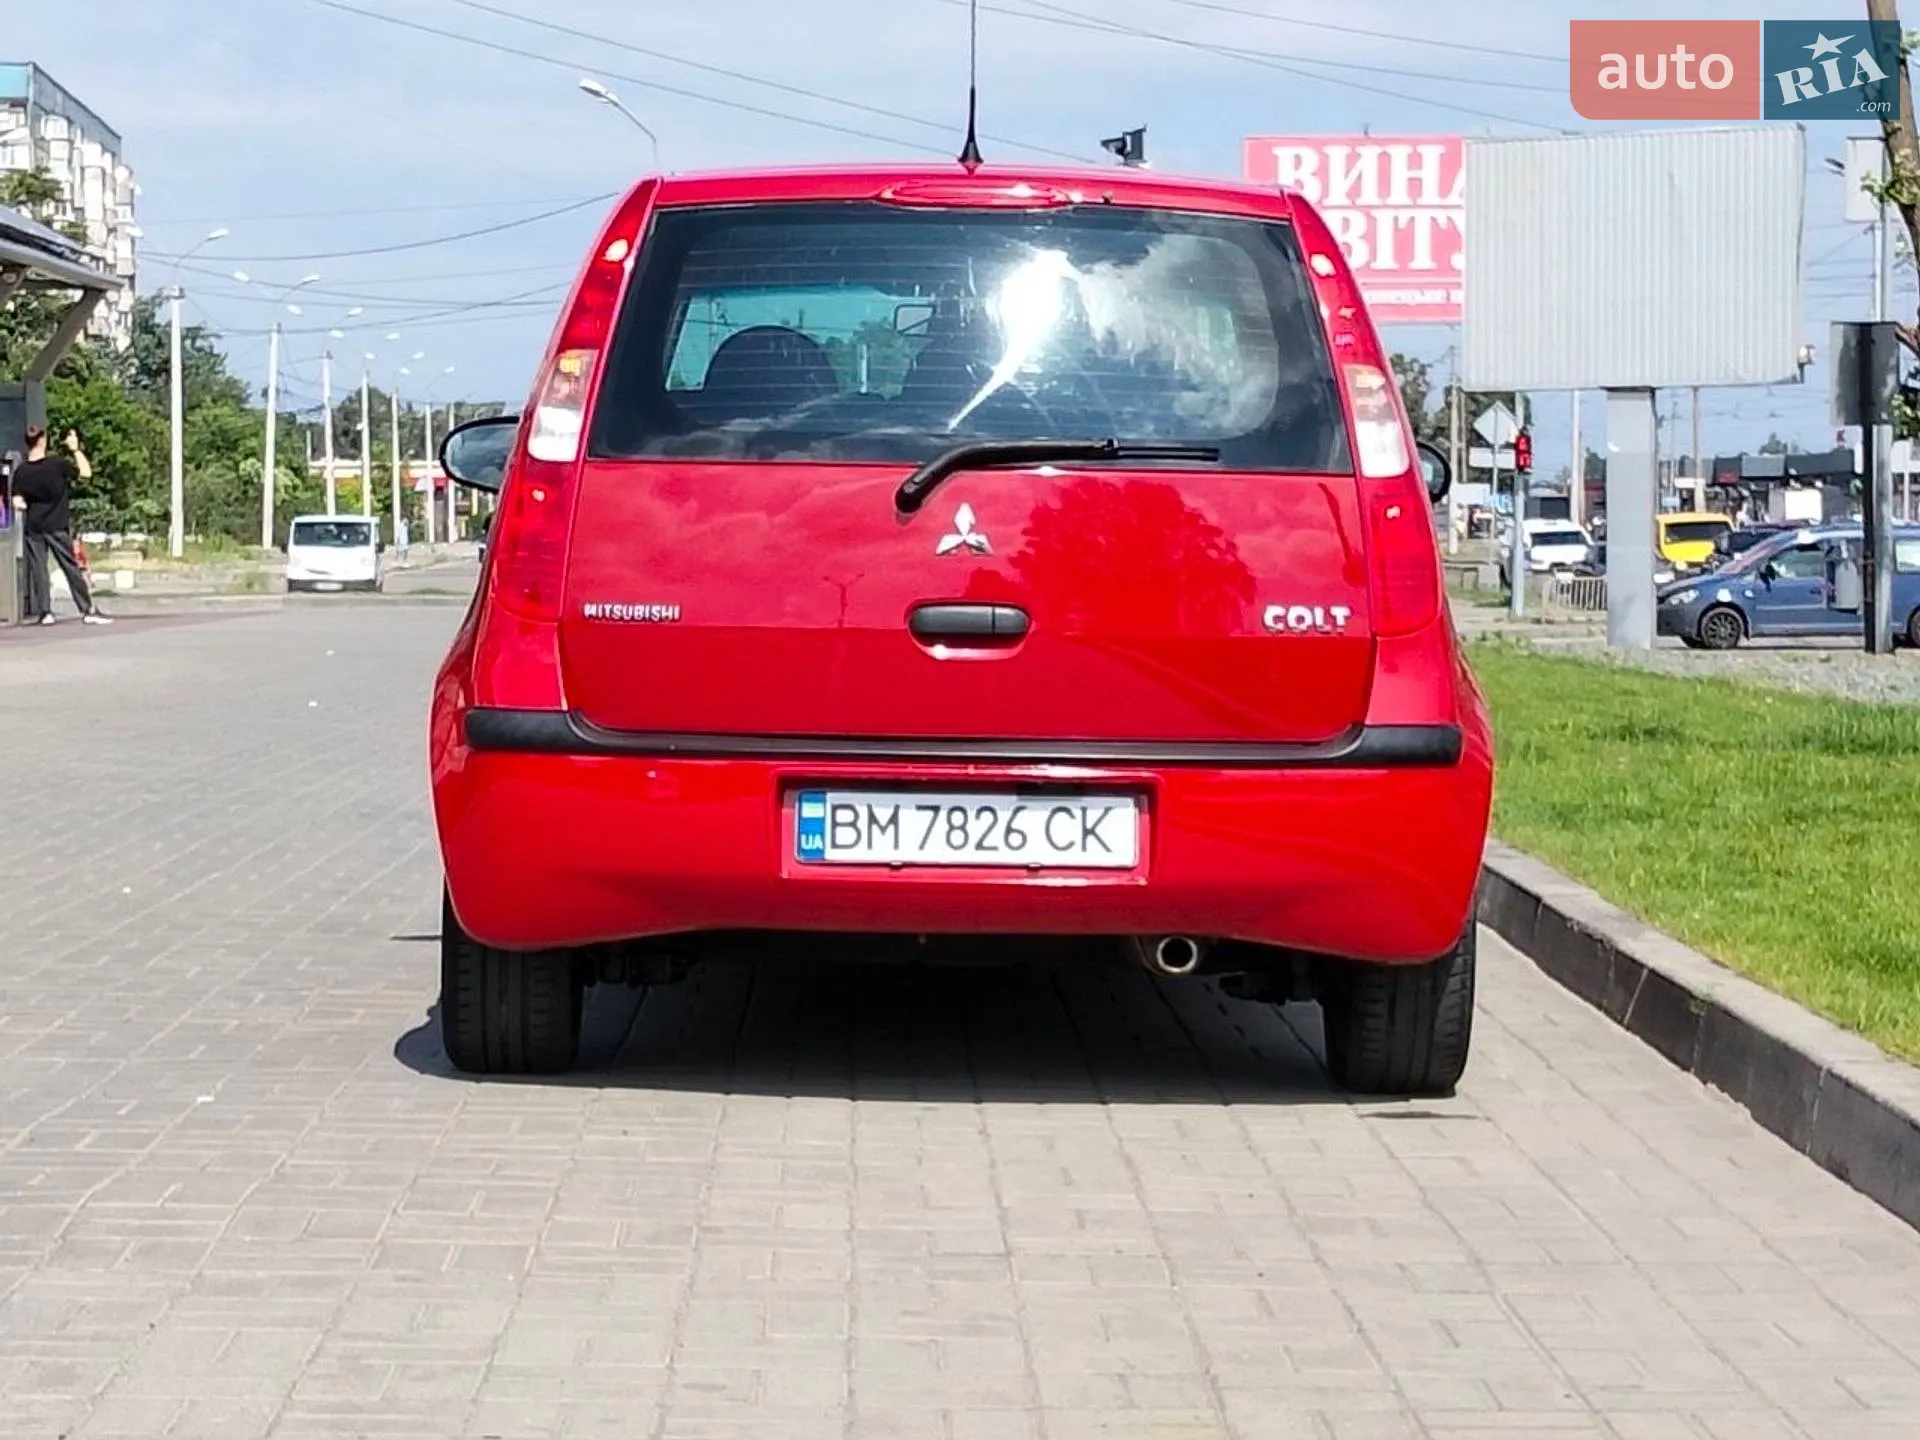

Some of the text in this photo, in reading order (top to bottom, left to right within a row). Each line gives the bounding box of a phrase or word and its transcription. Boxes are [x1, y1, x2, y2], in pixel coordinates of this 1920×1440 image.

[583, 603, 681, 621] MITSUBISHI
[1263, 604, 1352, 633] COLT
[830, 803, 1114, 854] BM 7826 CK
[800, 834, 824, 850] UA
